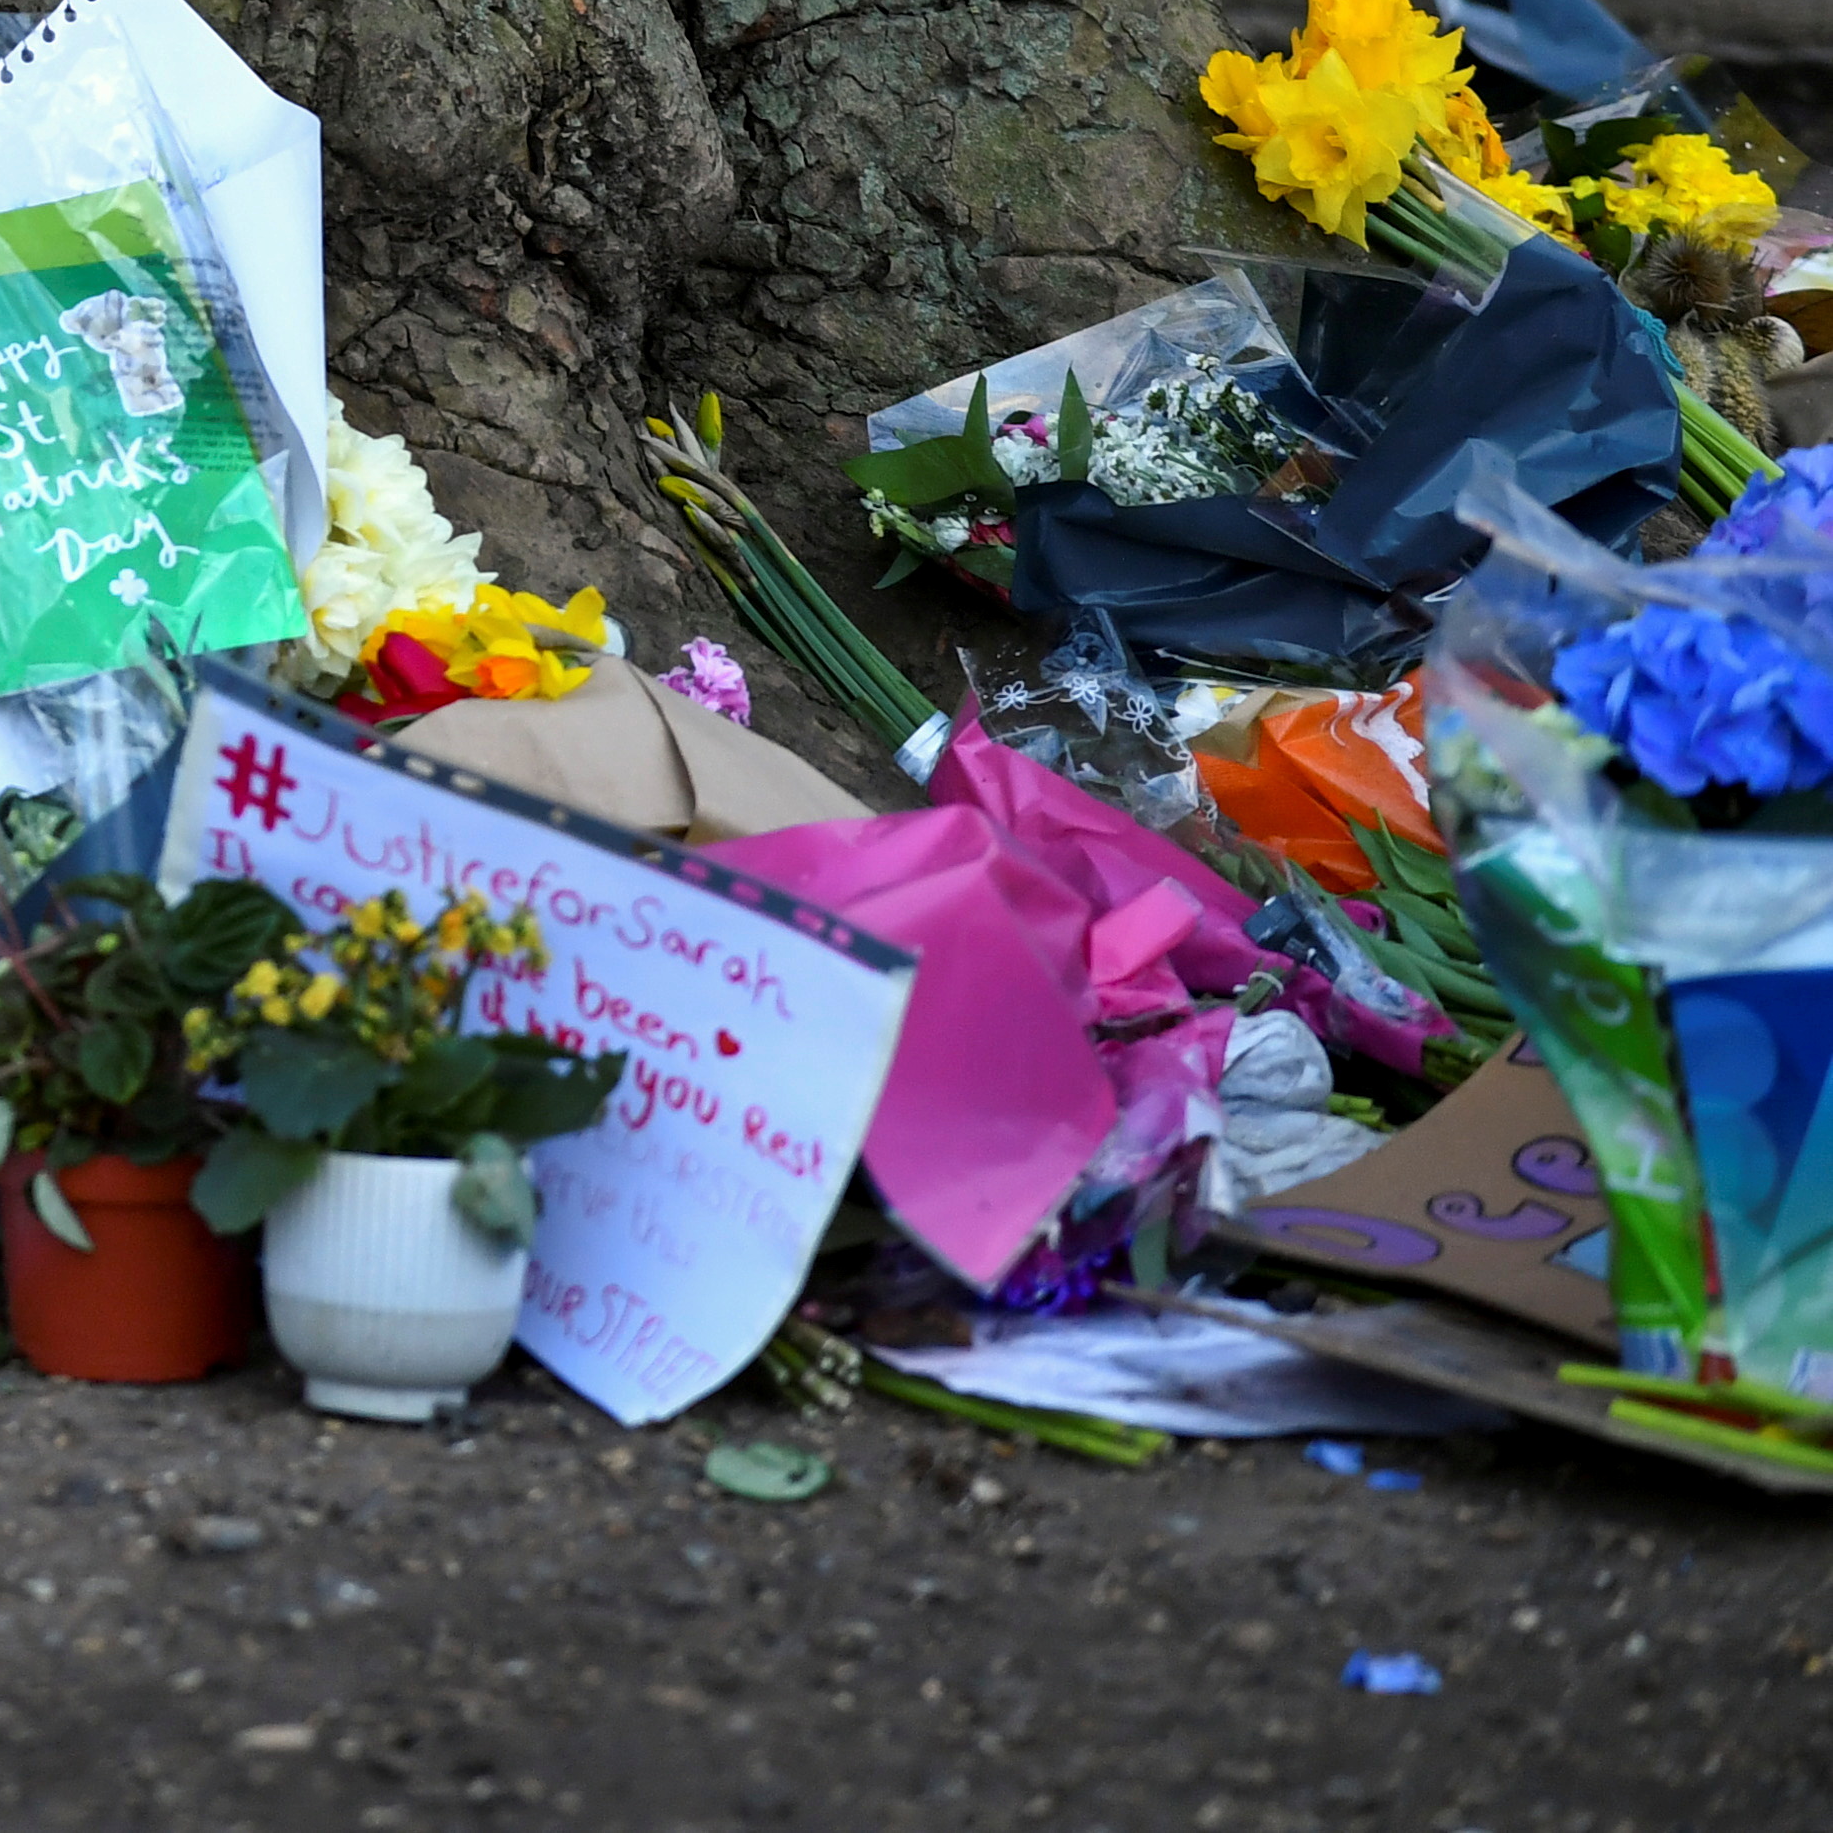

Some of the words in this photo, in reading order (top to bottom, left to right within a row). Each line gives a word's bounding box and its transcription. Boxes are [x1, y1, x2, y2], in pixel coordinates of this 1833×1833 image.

[32, 510, 201, 585] Day
[574, 955, 700, 1060] been
[619, 1059, 721, 1132] you
